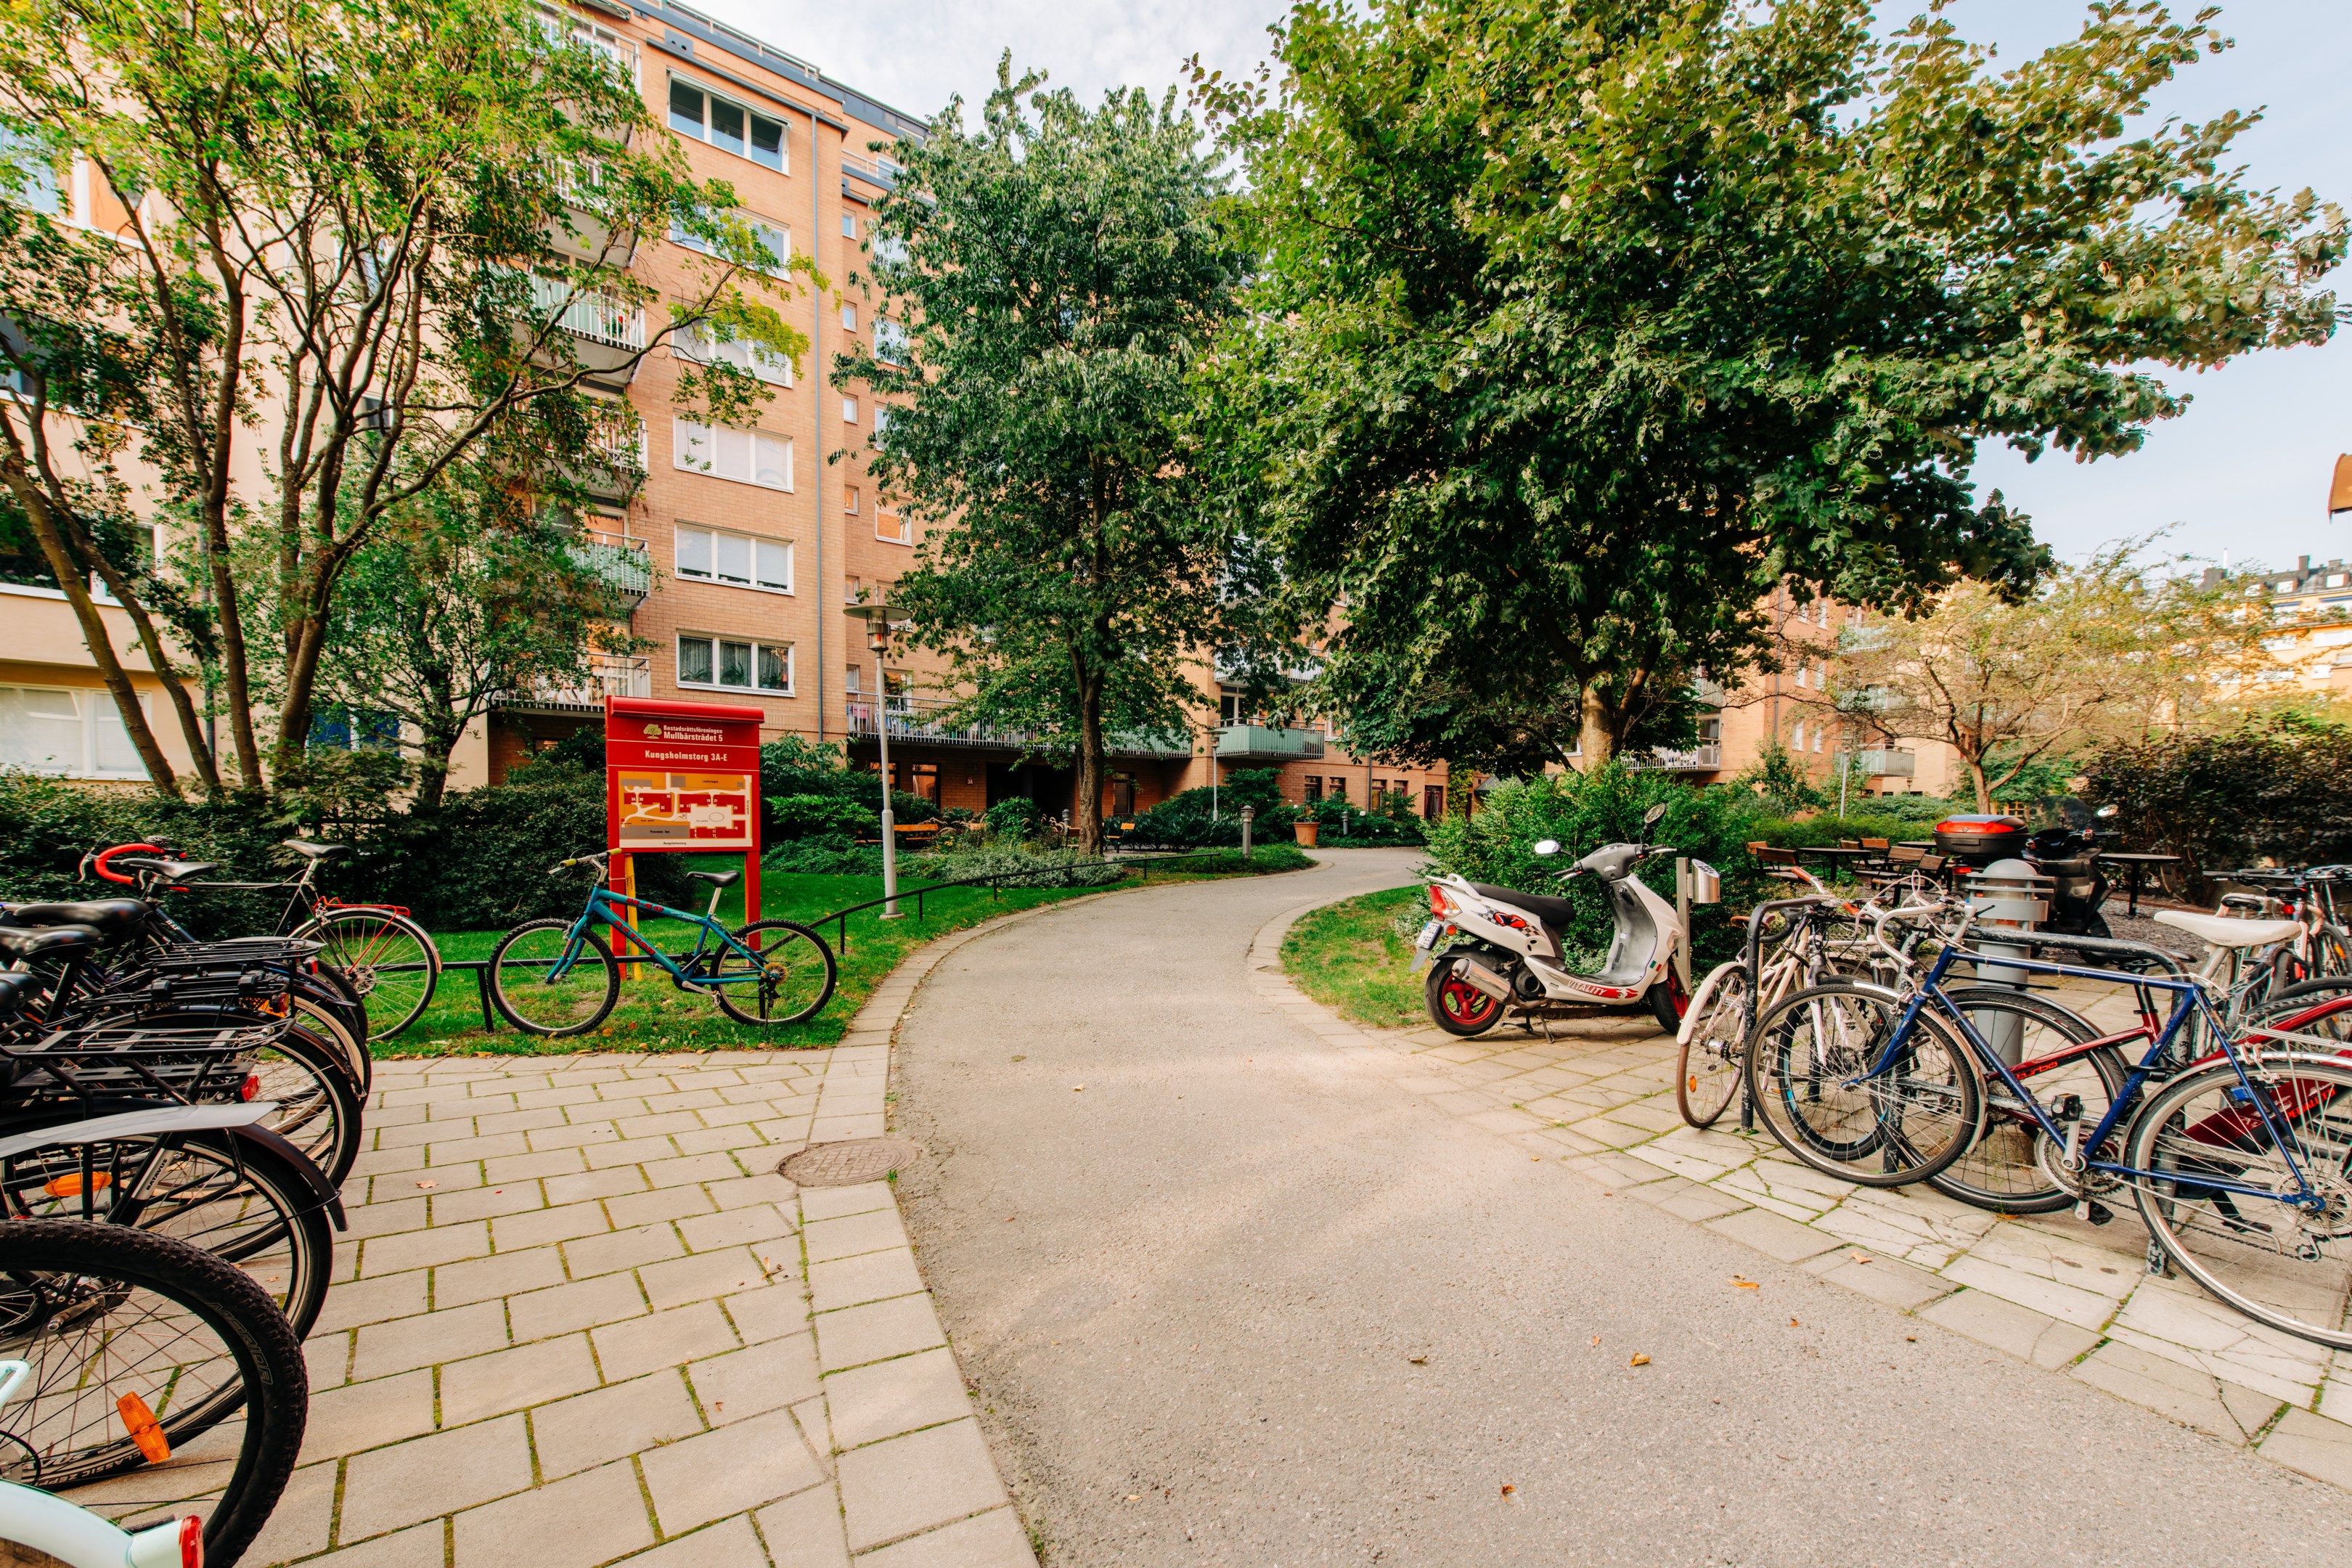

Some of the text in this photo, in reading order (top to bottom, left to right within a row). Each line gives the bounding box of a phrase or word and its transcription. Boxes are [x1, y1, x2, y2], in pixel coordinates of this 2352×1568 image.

[663, 724, 722, 734] Bostadsrättsföreningen
[645, 750, 727, 762] Kungsholmstorg 3A-E
[613, 920, 656, 955] ACTION
[1567, 980, 1608, 996] VITALITY
[145, 1158, 168, 1191] BATAVUS
[205, 1302, 274, 1385] MERIDA
[82, 1450, 142, 1478] CLASSIC
